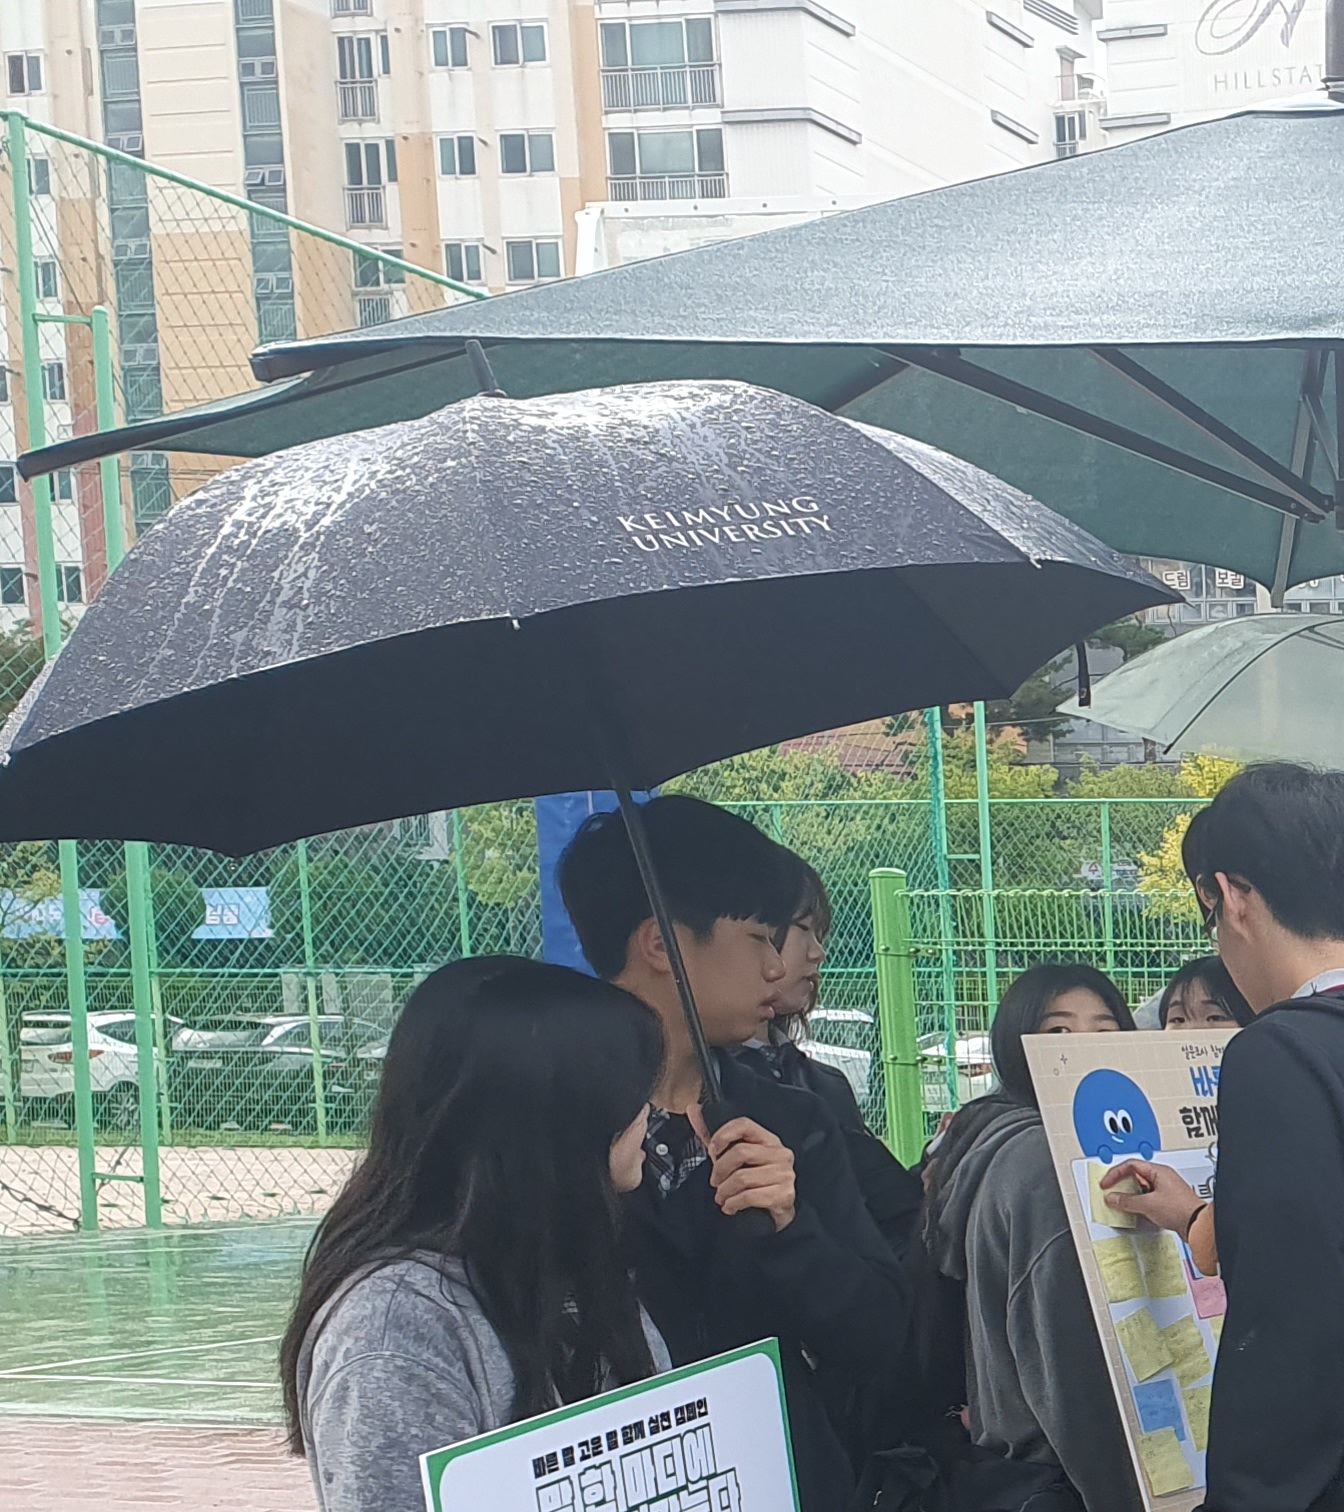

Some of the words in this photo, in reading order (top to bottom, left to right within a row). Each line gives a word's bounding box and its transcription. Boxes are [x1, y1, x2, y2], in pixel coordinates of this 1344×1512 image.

[1214, 64, 1325, 93] HILLSTAT
[617, 496, 819, 532] KEIMYUNG
[632, 514, 831, 552] UNIVERSITY
